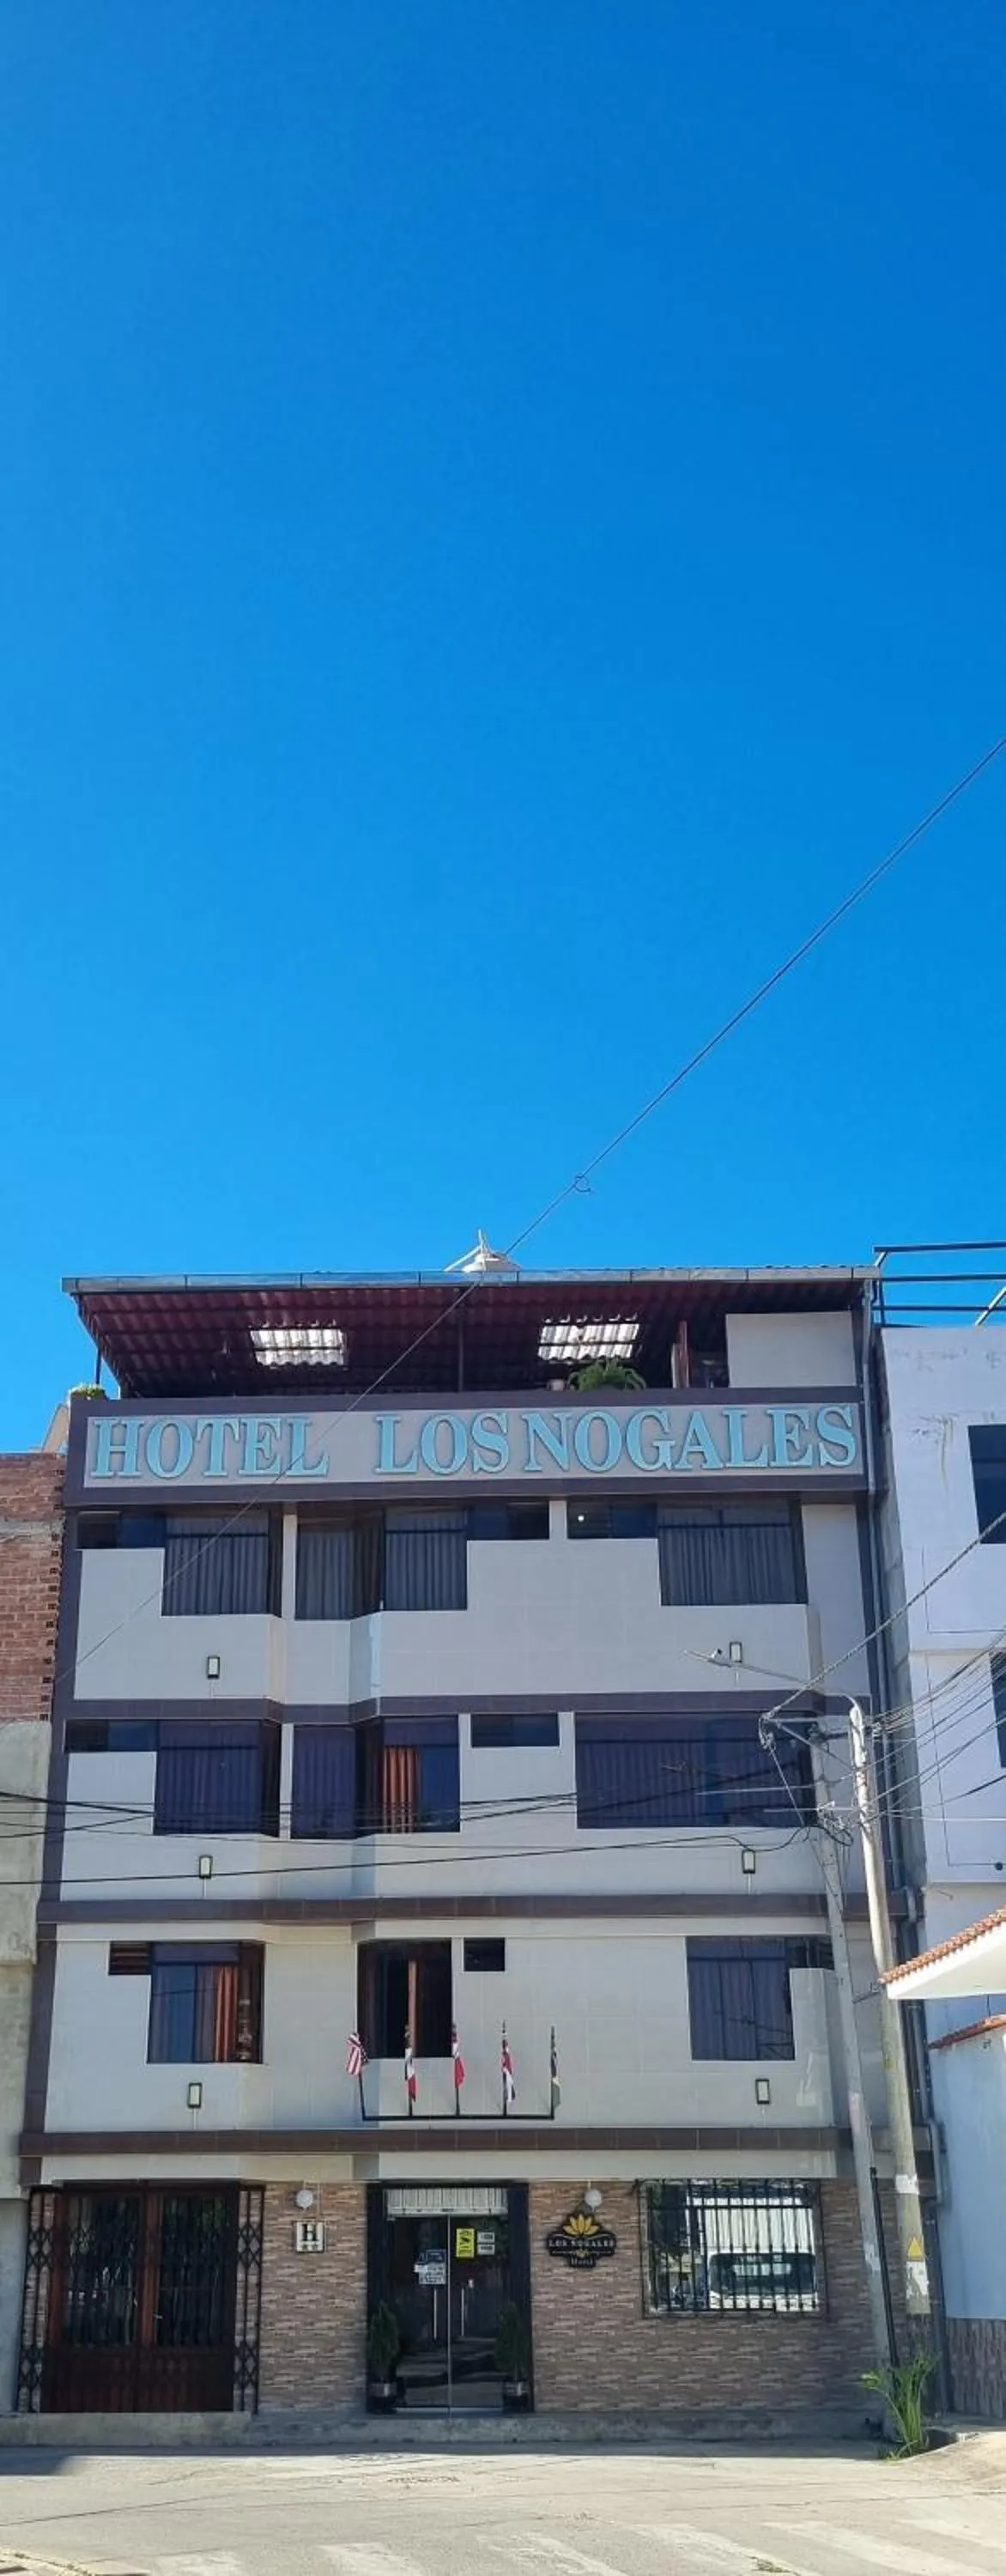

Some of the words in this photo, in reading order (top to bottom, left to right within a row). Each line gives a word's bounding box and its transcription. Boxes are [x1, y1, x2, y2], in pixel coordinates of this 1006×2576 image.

[91, 1418, 329, 1479] HOTEL
[375, 1413, 510, 1474] LOS
[522, 1406, 857, 1472] NOGALES
[301, 2223, 318, 2241] H
